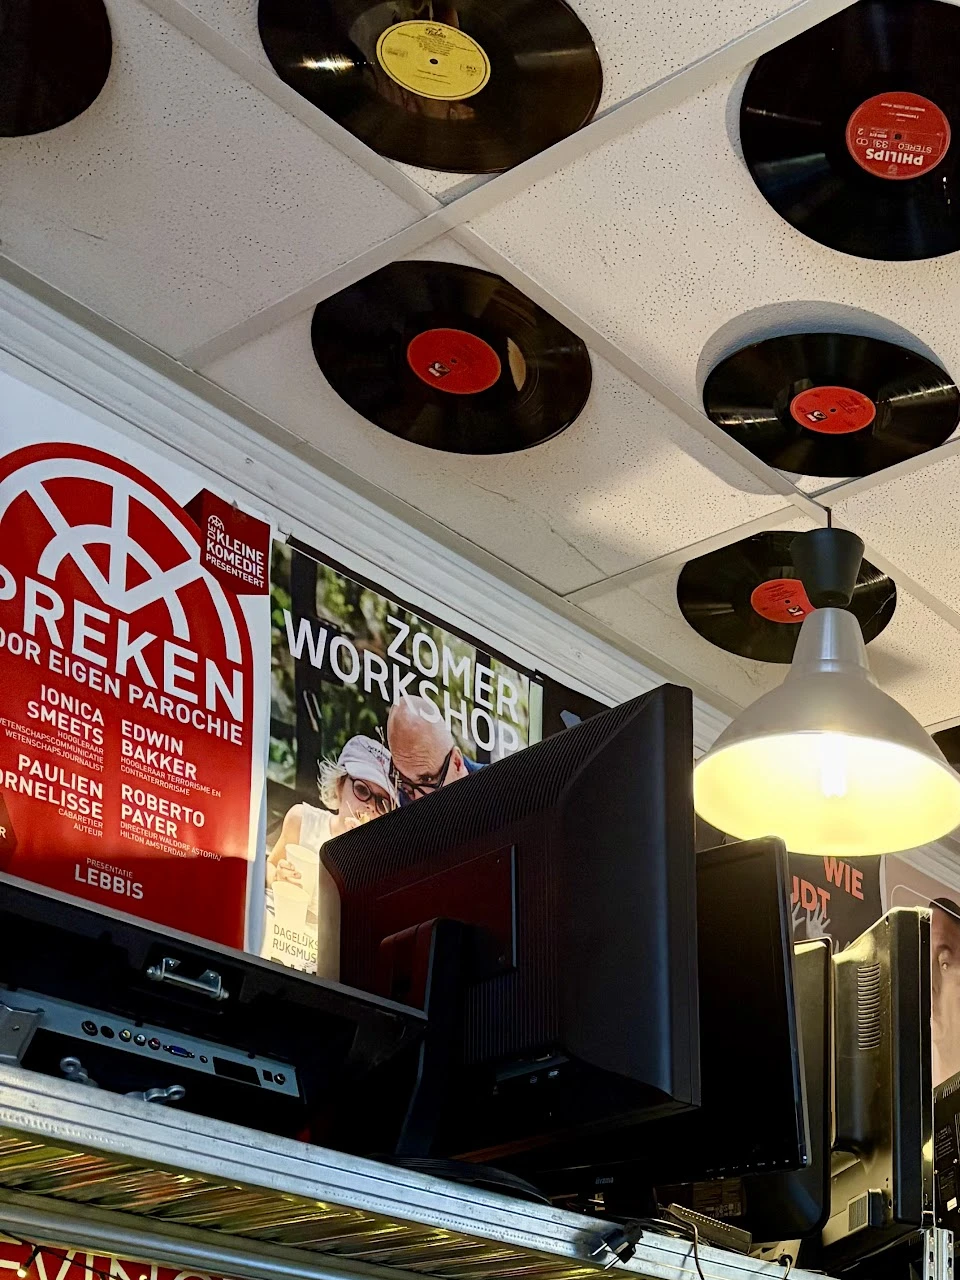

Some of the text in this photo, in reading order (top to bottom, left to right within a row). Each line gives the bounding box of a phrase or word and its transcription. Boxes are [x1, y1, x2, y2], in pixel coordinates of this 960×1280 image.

[866, 148, 924, 166] PHILIPS
[898, 143, 933, 154] STEREO
[206, 540, 264, 578] KOMEDIE
[216, 530, 265, 564] KLEINE
[205, 554, 264, 588] PRESENTEERT
[282, 609, 520, 758] WORKSHOP
[386, 616, 519, 723] ZOMER
[41, 684, 104, 726] IONICA
[49, 648, 120, 699] EIGEN
[129, 684, 243, 746] PAROCHIE
[27, 700, 104, 745] SMEETS
[121, 720, 183, 756] EDWIN
[57, 730, 104, 754] HOOGLERAAR
[122, 739, 197, 780] BAKKER
[18, 753, 103, 800] PAULIEN
[120, 757, 164, 781] HOOGLERAAR
[166, 769, 211, 796] TERRORISME
[120, 765, 190, 797] CONTRATERRORISME
[58, 807, 103, 830] CABARETIER
[121, 785, 205, 828] ROBERTO
[121, 803, 178, 839] PAYER
[73, 822, 103, 838] AUTEUR
[120, 821, 160, 843] DIRECTEUR
[120, 830, 187, 859] HILTON AMSTERDAM
[74, 864, 144, 900] LEBBIS
[86, 857, 133, 879] PRESENTATIE
[823, 856, 864, 900] WIE
